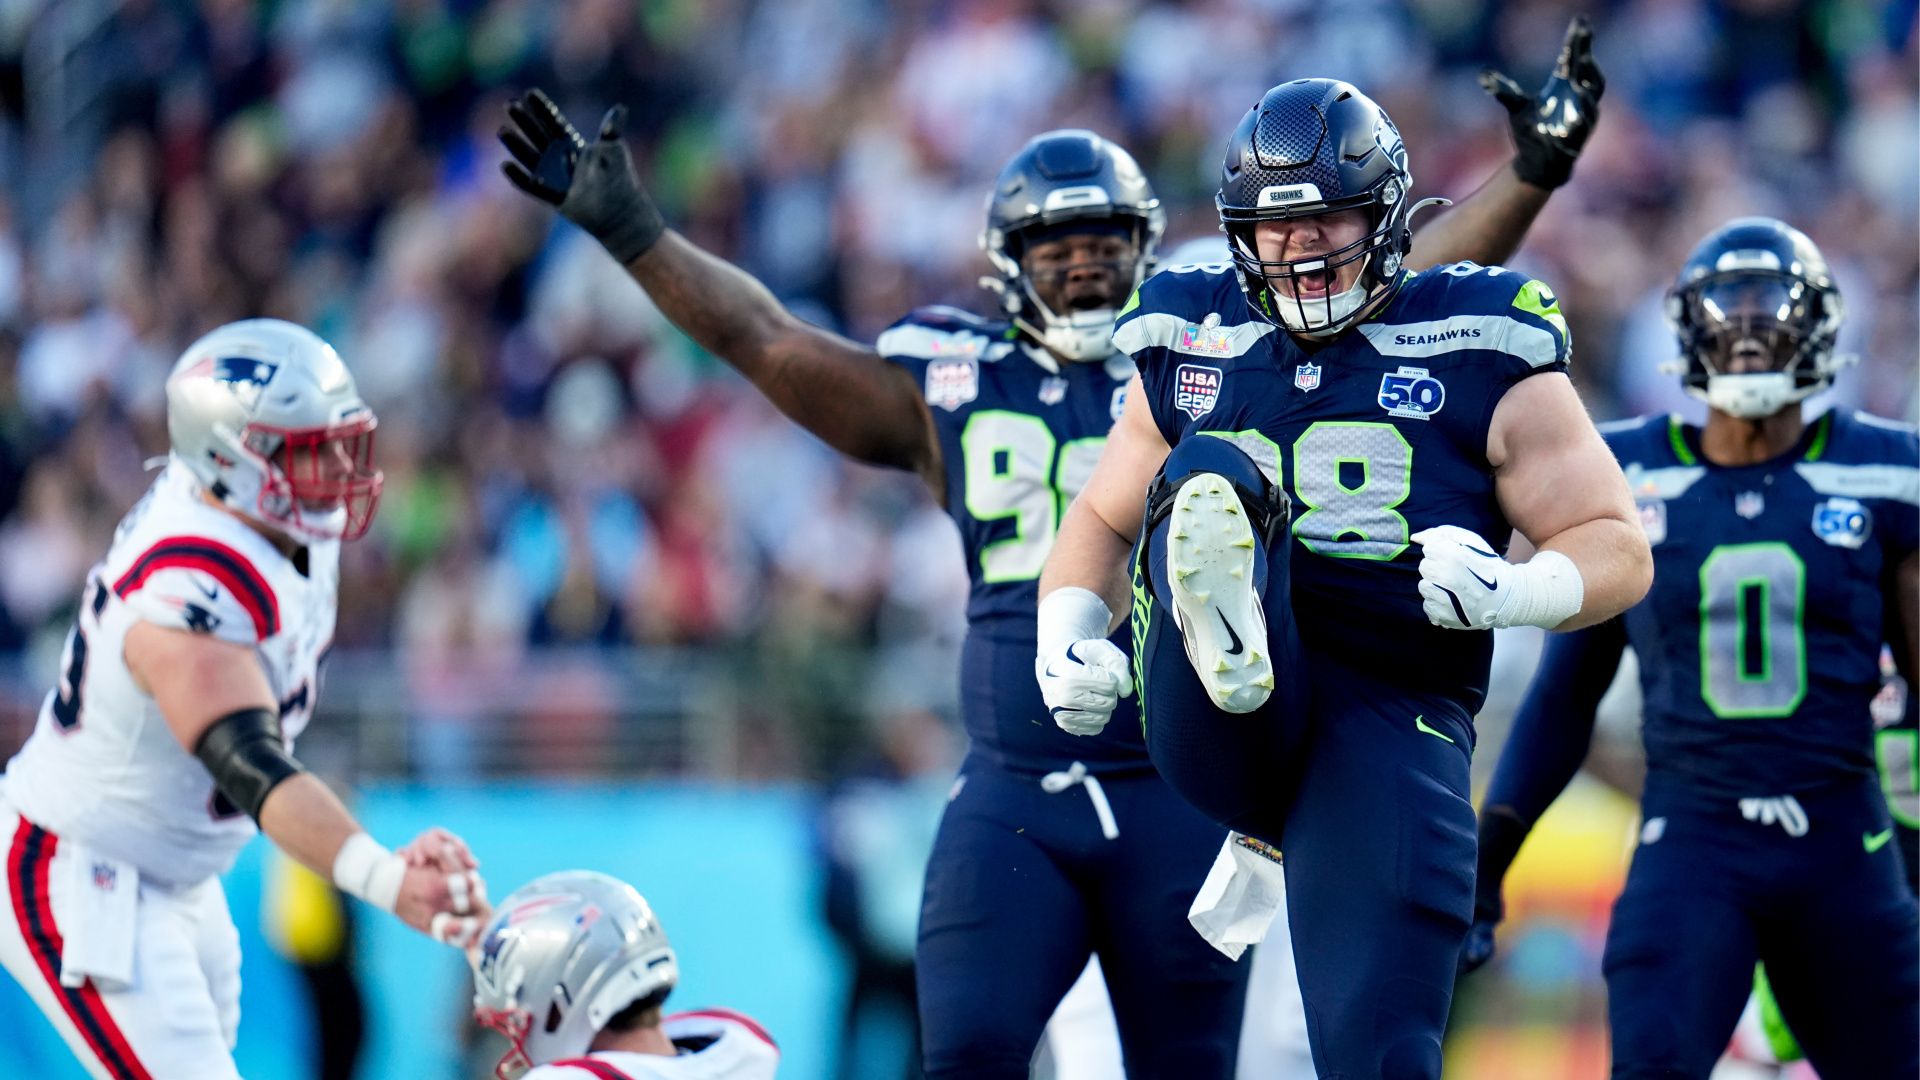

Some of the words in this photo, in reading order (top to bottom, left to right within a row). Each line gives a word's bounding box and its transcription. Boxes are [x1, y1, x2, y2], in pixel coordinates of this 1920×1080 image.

[1270, 189, 1304, 202] SEAHAWKS
[1394, 328, 1482, 345] SEAHAWKS
[1181, 371, 1217, 387] USA
[1299, 374, 1317, 387] NFL
[1178, 392, 1215, 410] 250
[1380, 375, 1444, 413] 50
[1699, 541, 1808, 719] 0
